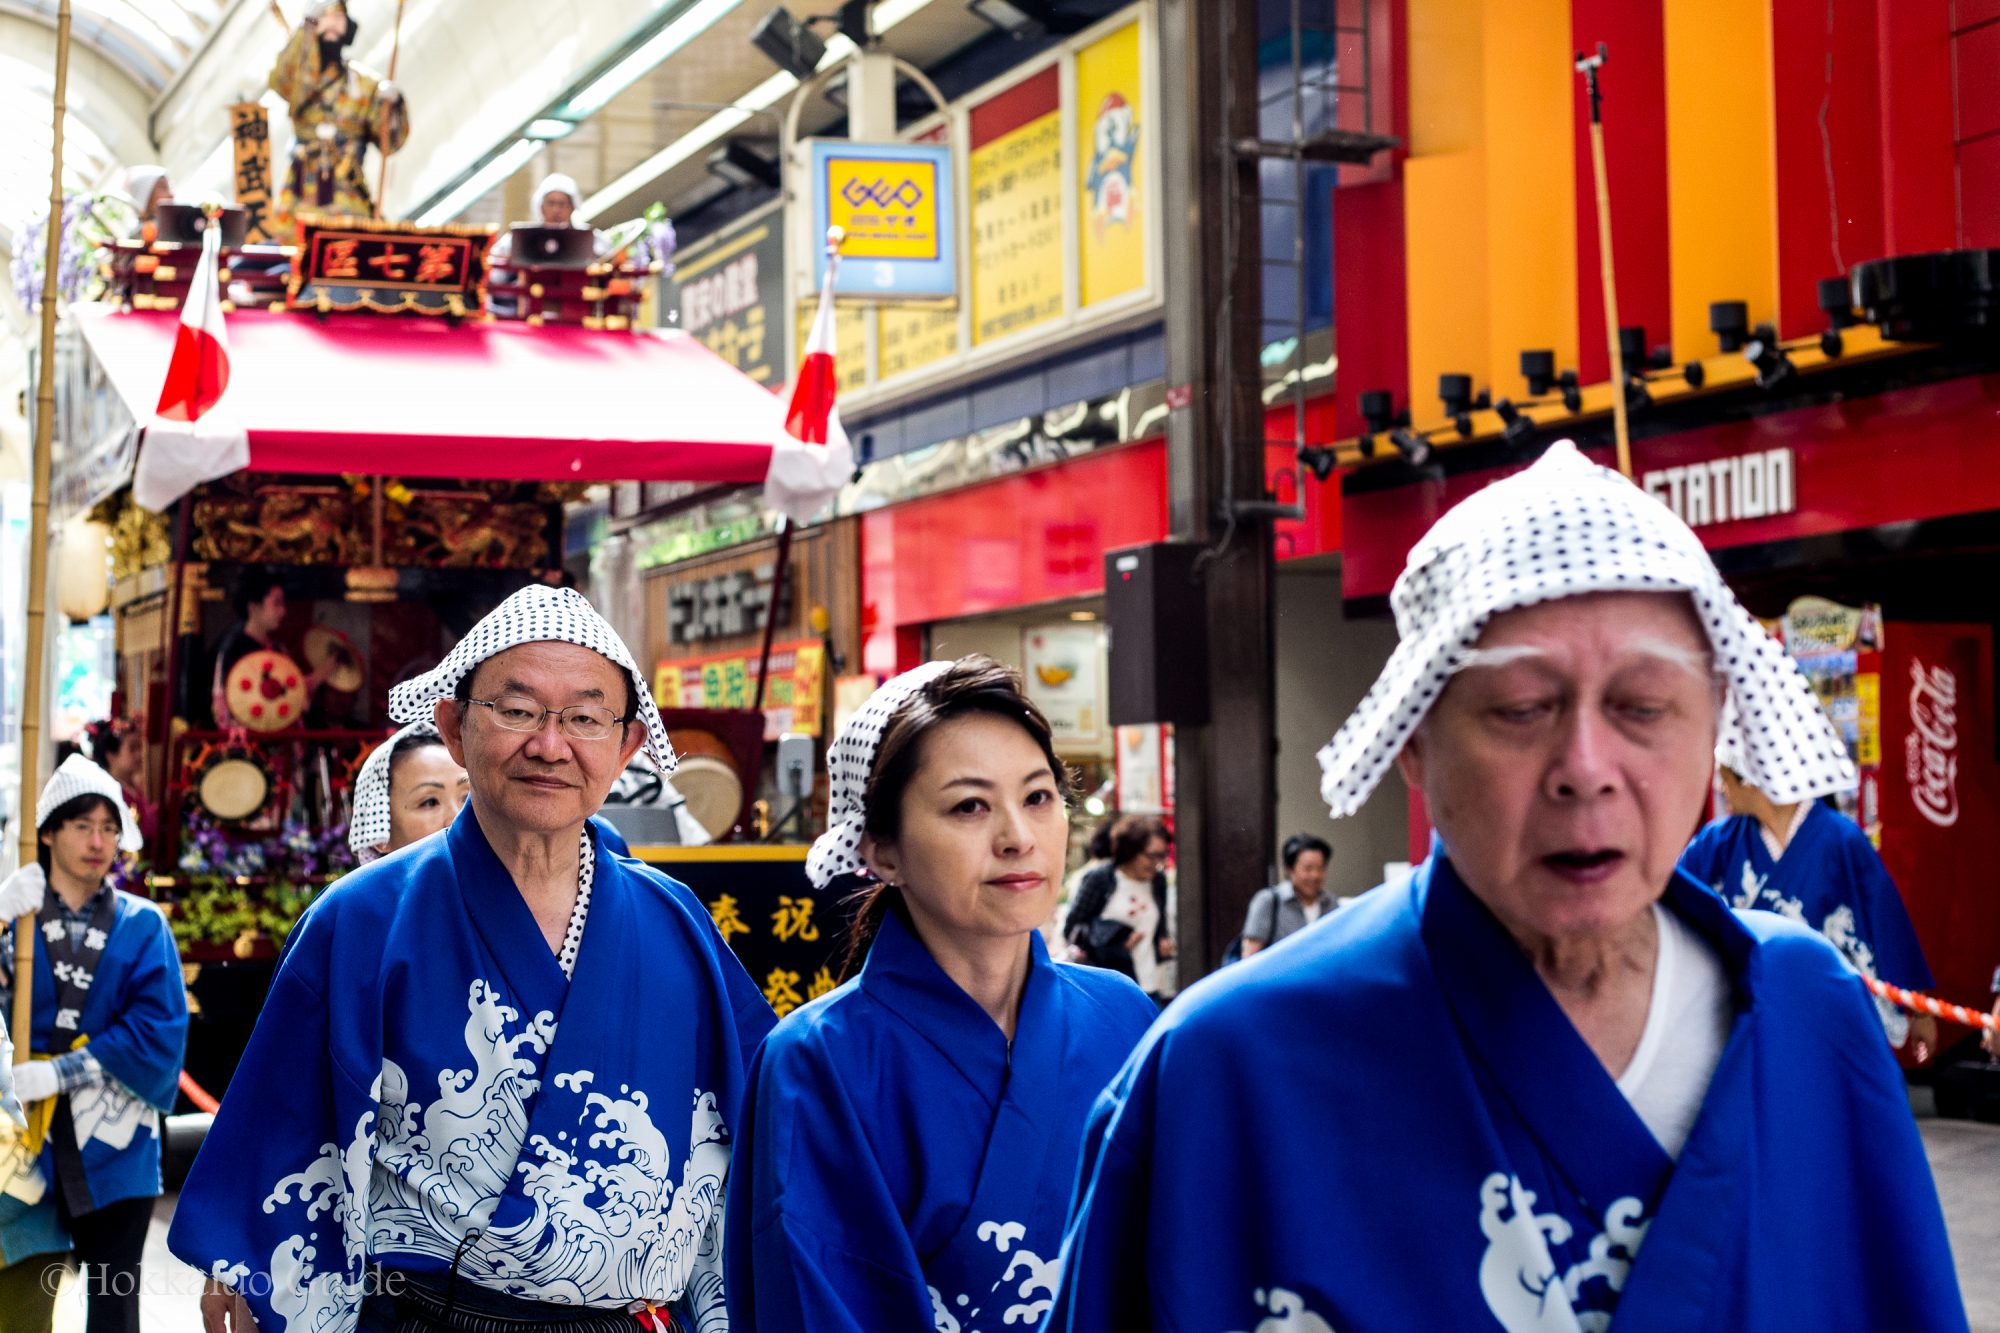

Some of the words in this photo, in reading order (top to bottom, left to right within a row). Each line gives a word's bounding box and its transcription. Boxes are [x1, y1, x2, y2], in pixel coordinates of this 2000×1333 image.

[841, 177, 923, 209] GEO
[1643, 447, 1792, 528] STATION
[709, 893, 820, 943] 奉祝
